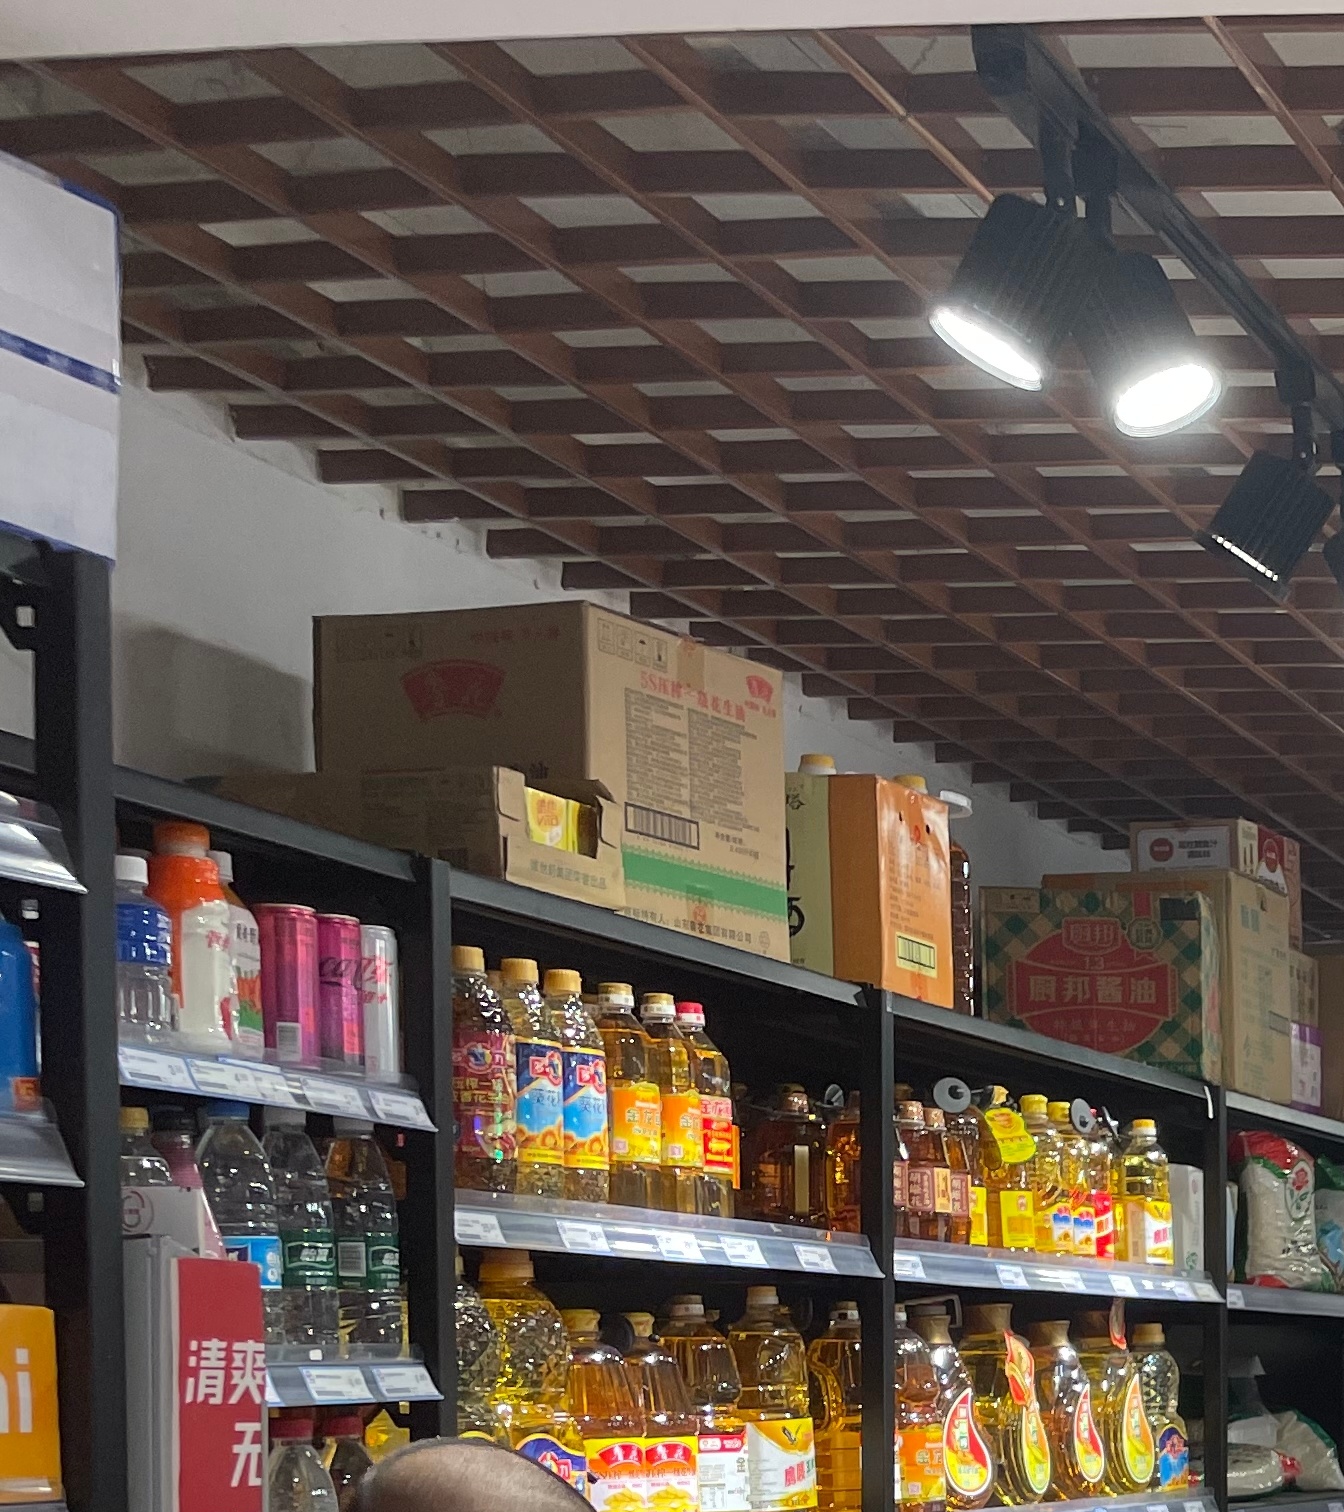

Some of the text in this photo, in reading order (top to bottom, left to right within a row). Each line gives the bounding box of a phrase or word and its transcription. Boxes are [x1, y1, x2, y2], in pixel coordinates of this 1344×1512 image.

[1029, 975, 1157, 1005] 厨邦酱油
[184, 1338, 264, 1405] 清爽
